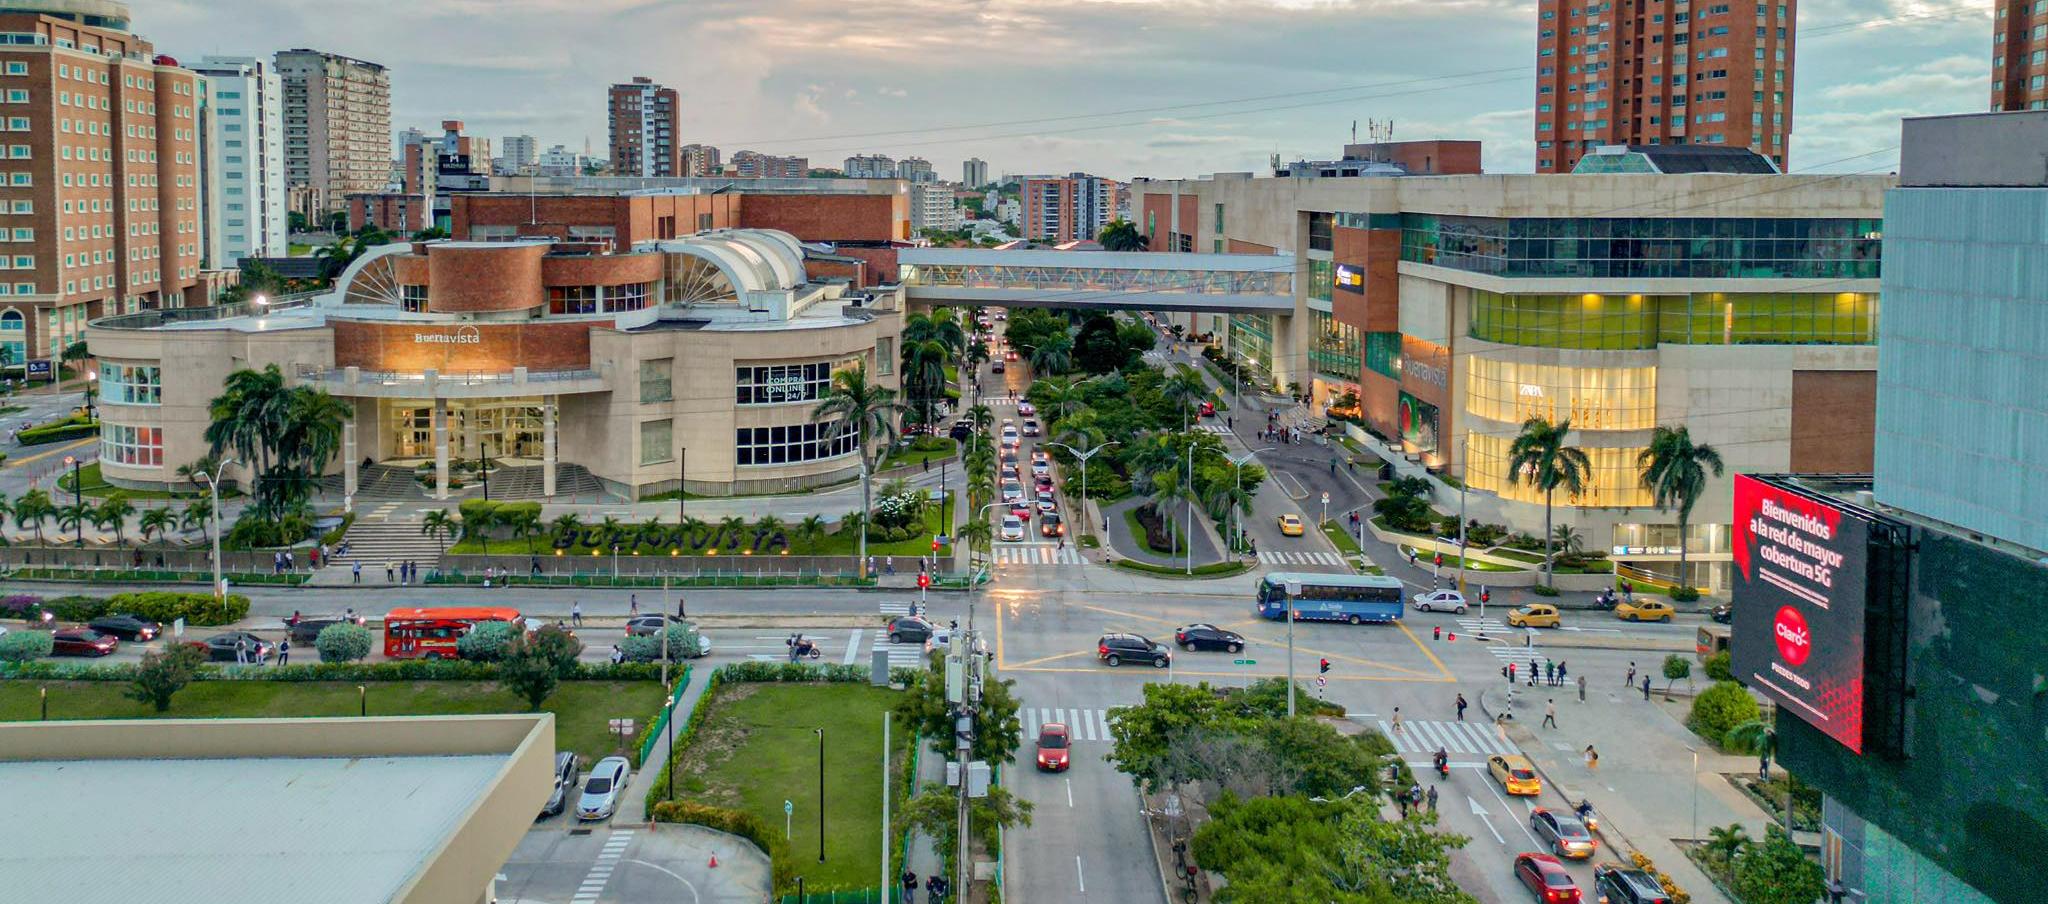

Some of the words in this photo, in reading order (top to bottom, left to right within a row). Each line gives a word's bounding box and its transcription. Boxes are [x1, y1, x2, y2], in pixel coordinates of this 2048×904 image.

[1762, 498, 1830, 540] Bienvenidos
[1750, 519, 1757, 532] a
[1758, 518, 1768, 537] la
[1769, 525, 1787, 545] red
[1788, 531, 1802, 553] de
[1803, 541, 1843, 568] mayor
[1760, 545, 1814, 580] cobertura
[1814, 565, 1831, 587] 5G
[1776, 622, 1803, 646] Claro
